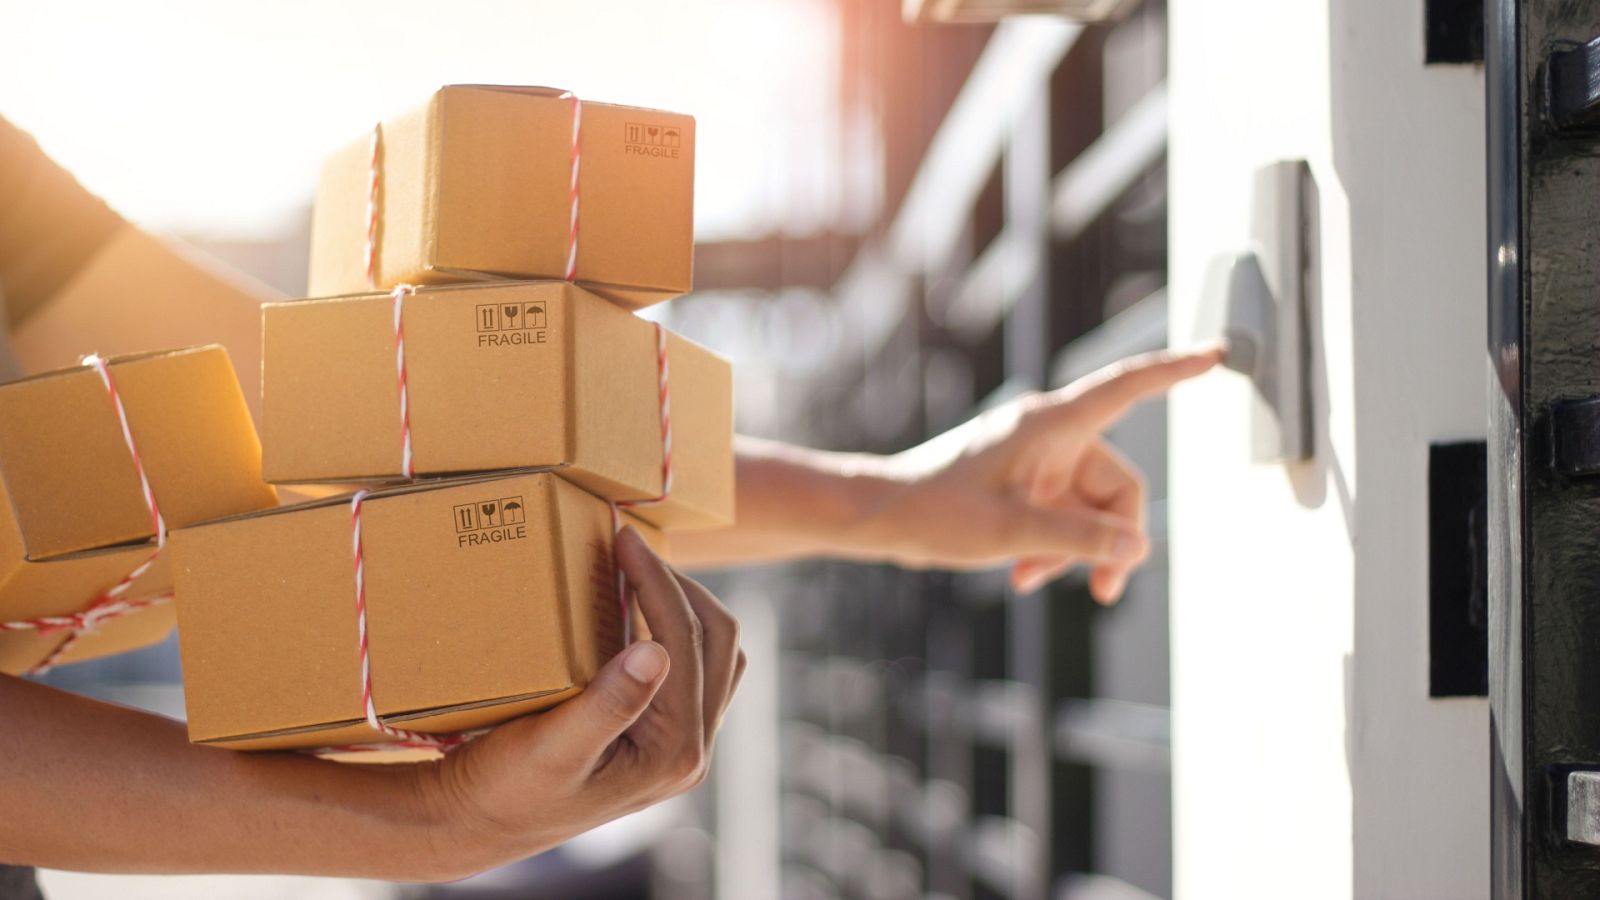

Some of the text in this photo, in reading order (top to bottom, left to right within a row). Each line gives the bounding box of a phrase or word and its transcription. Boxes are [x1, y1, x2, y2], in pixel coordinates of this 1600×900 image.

[625, 144, 680, 159] FRAGILE
[478, 331, 547, 347] FRAGILE
[458, 526, 527, 548] FRAGILE
